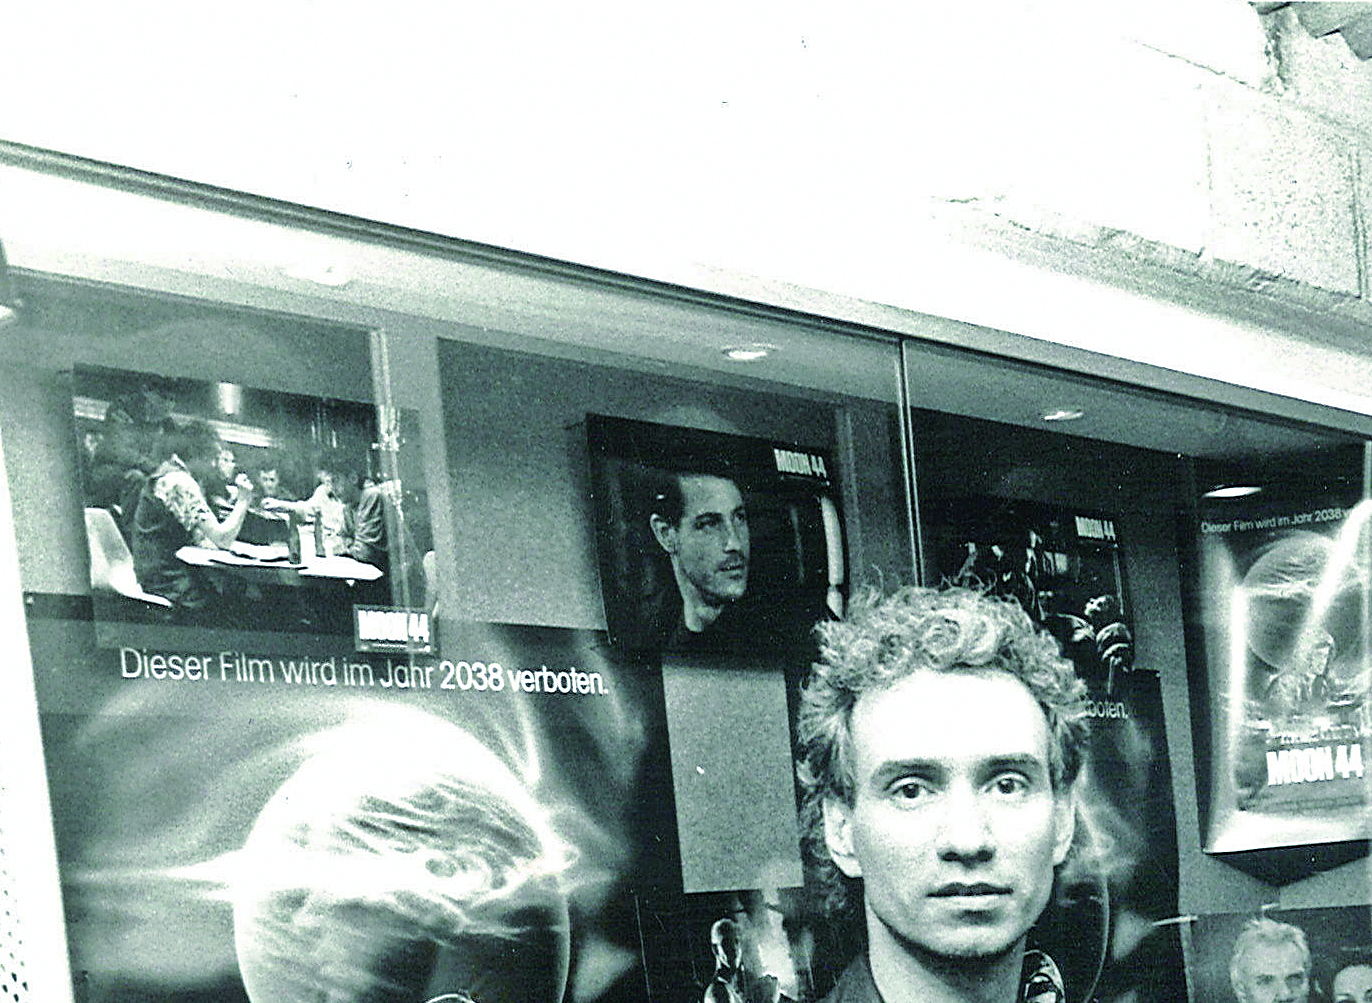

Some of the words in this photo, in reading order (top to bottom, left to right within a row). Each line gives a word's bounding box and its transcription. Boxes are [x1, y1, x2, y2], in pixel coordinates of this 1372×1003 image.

[1314, 508, 1341, 523] 2038
[119, 648, 211, 682] Dieser
[219, 653, 274, 686] Film
[282, 656, 337, 689] wird
[342, 659, 373, 688] im
[379, 663, 433, 690] Jahr
[439, 664, 504, 692] 2038
[508, 668, 609, 697] verboten.
[1335, 743, 1365, 779] 44
